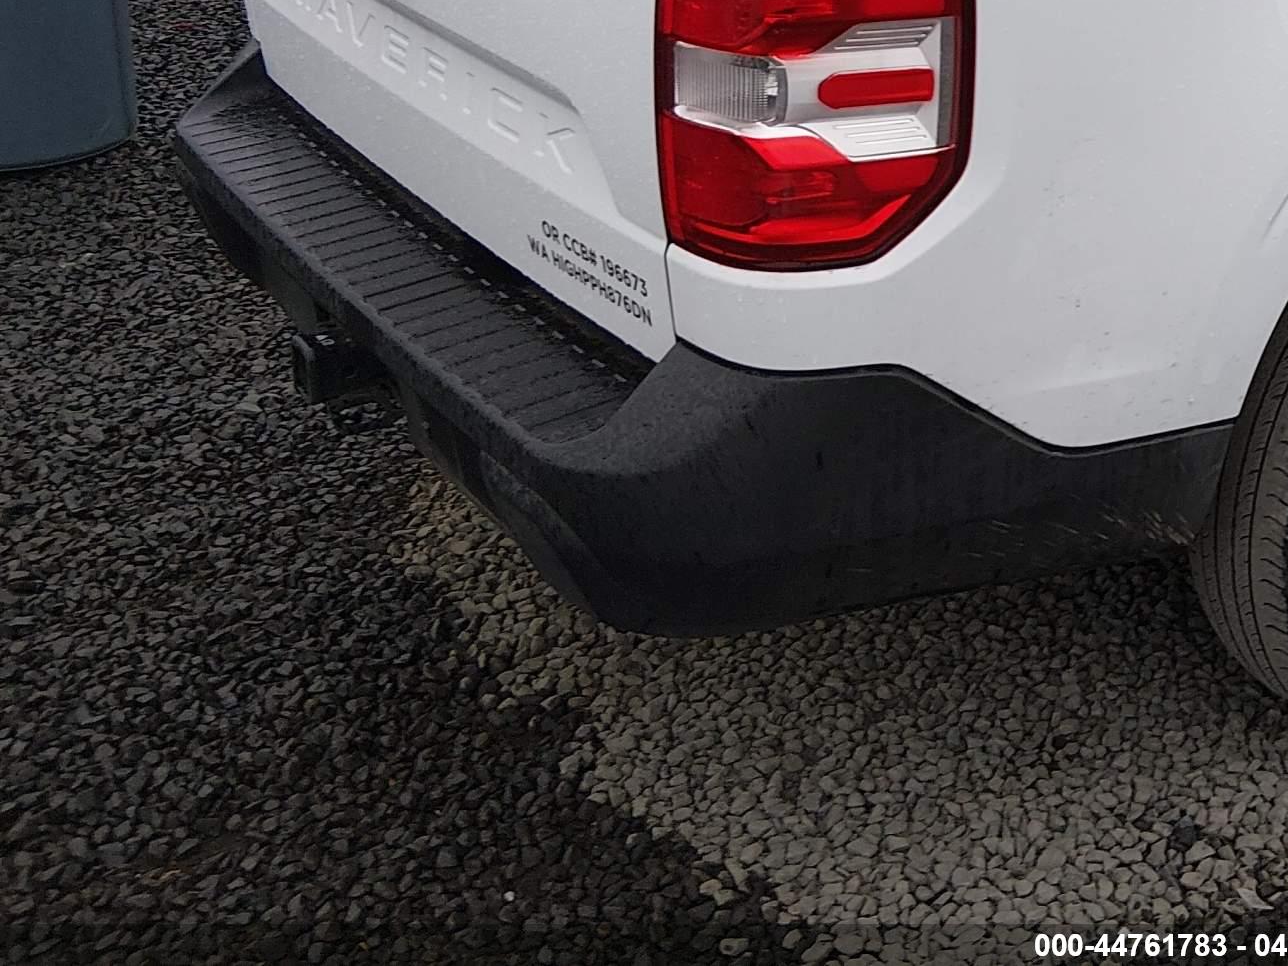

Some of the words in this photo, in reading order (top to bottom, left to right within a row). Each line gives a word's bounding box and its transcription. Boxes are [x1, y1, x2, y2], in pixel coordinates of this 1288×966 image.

[526, 234, 551, 263] WA
[541, 220, 561, 244] OR
[562, 233, 598, 267] CCB#
[600, 254, 648, 297] 196673
